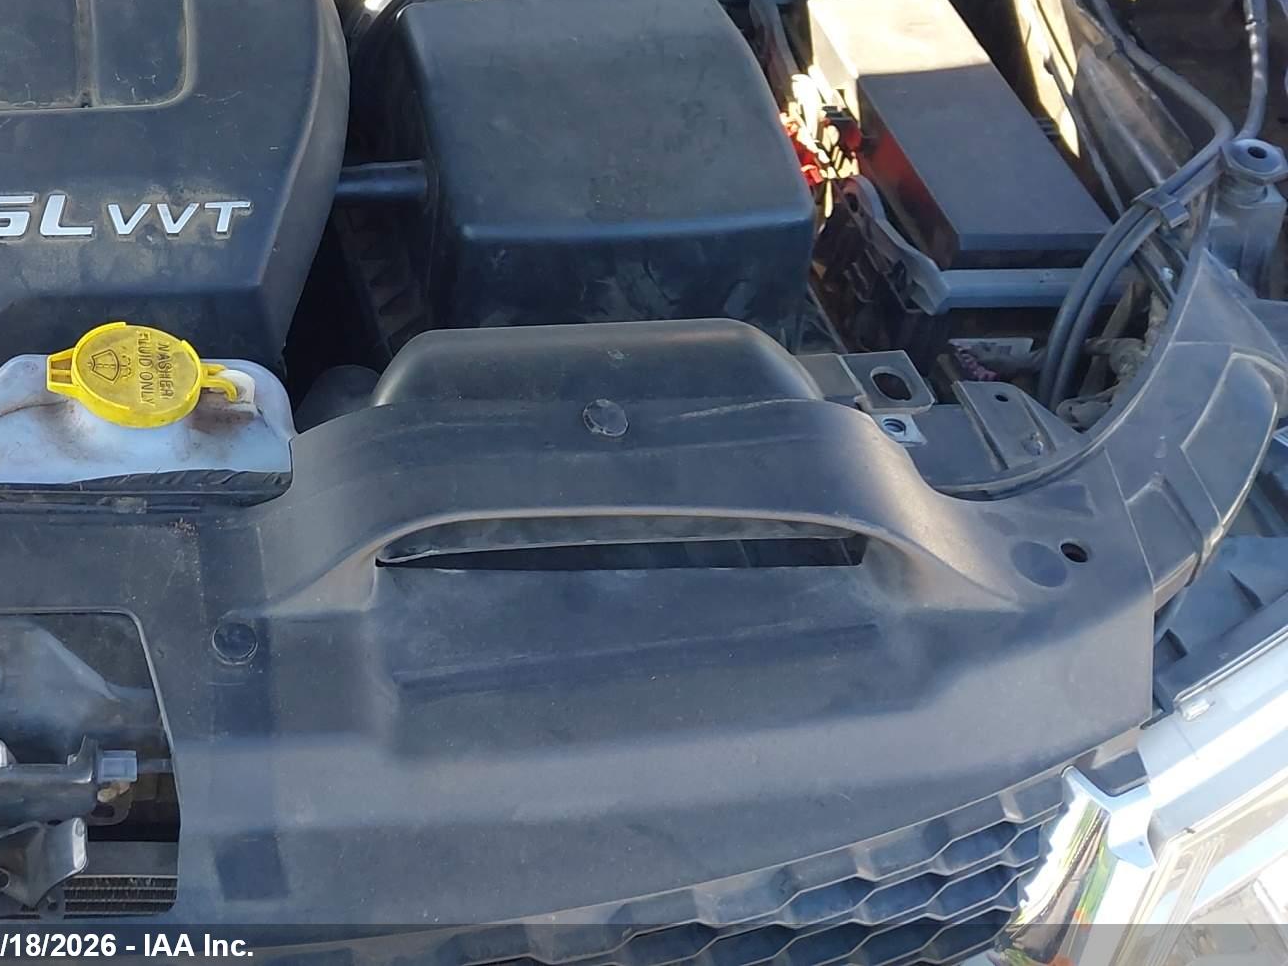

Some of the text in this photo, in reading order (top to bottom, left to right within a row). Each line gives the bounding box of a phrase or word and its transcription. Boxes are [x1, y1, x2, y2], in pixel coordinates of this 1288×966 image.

[108, 201, 251, 235] VVT
[136, 329, 156, 407] FLUID ONLY
